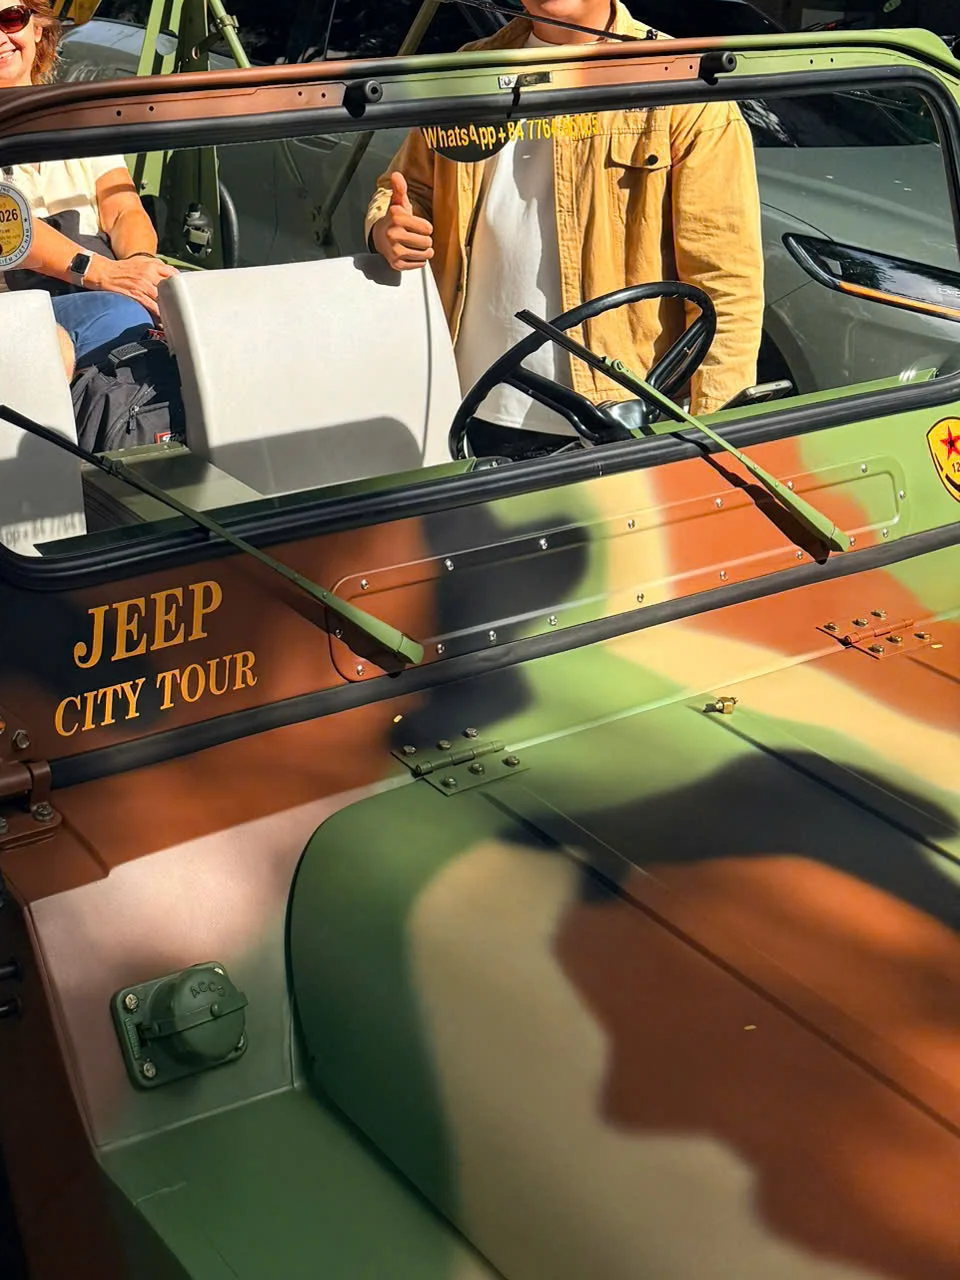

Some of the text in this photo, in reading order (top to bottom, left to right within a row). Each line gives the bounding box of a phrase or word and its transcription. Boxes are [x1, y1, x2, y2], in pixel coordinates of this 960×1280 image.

[73, 580, 223, 669] JEEP
[54, 650, 258, 737] CITY TOUR
